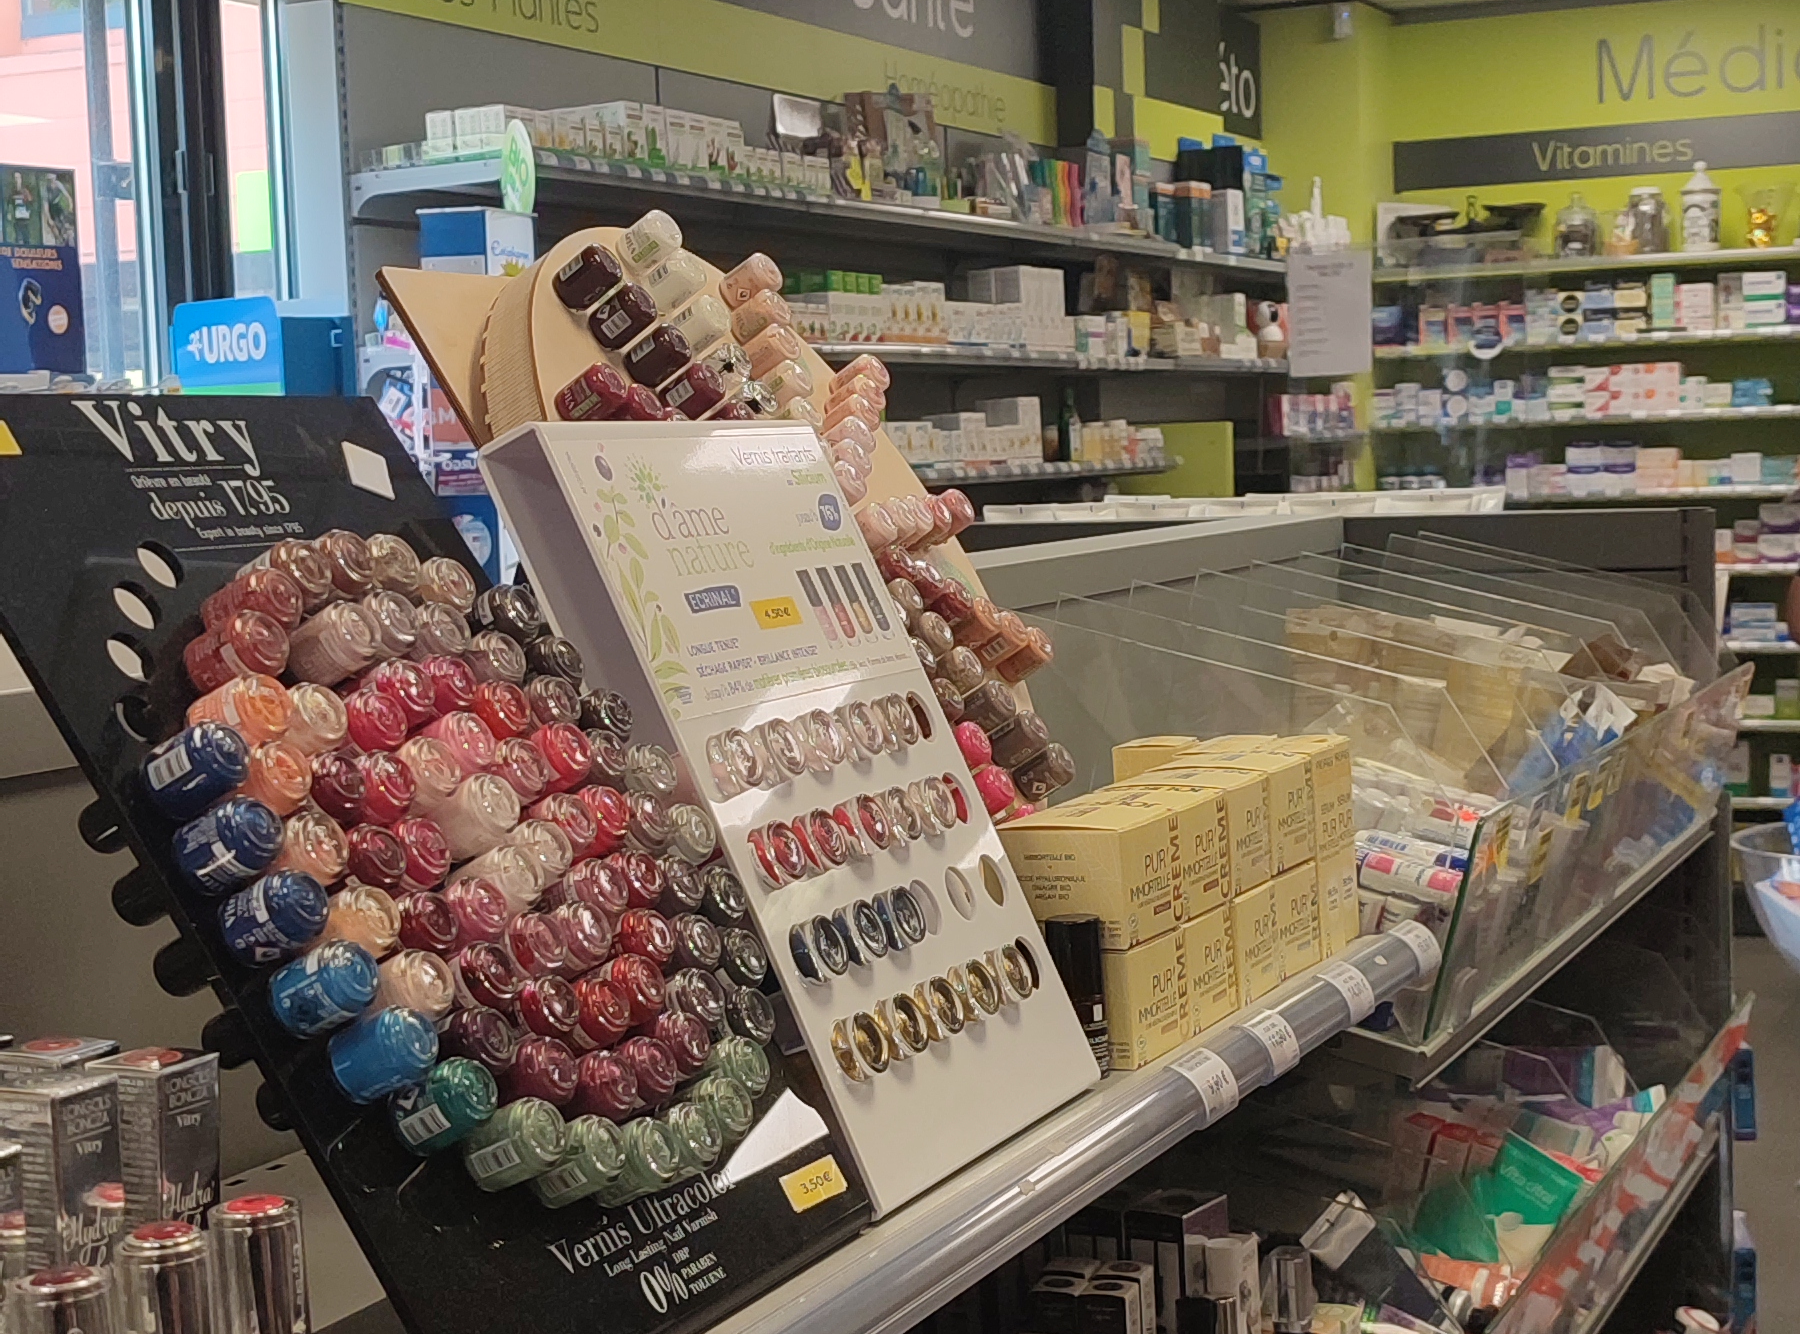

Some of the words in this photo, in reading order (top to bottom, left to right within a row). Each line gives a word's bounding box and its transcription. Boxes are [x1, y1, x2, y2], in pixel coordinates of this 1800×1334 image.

[1532, 137, 1694, 172] Vitamines
[202, 321, 267, 364] URGO
[70, 399, 262, 477] Vitry
[730, 445, 773, 467] Vernis
[148, 491, 227, 530] depuis
[216, 479, 291, 516] 1795
[651, 496, 731, 542] d'âme
[666, 537, 755, 577] nature
[688, 588, 735, 610] ECRINAL
[546, 1215, 633, 1275] Vernis
[626, 1167, 737, 1235] Ultracolor
[603, 1256, 634, 1278] Long
[629, 1238, 668, 1264] Lasting
[663, 1224, 686, 1246] Nail
[682, 1206, 719, 1234] Varnish
[671, 1246, 691, 1265] DBP
[680, 1250, 719, 1280] PARABEN
[640, 1260, 689, 1314] 0%
